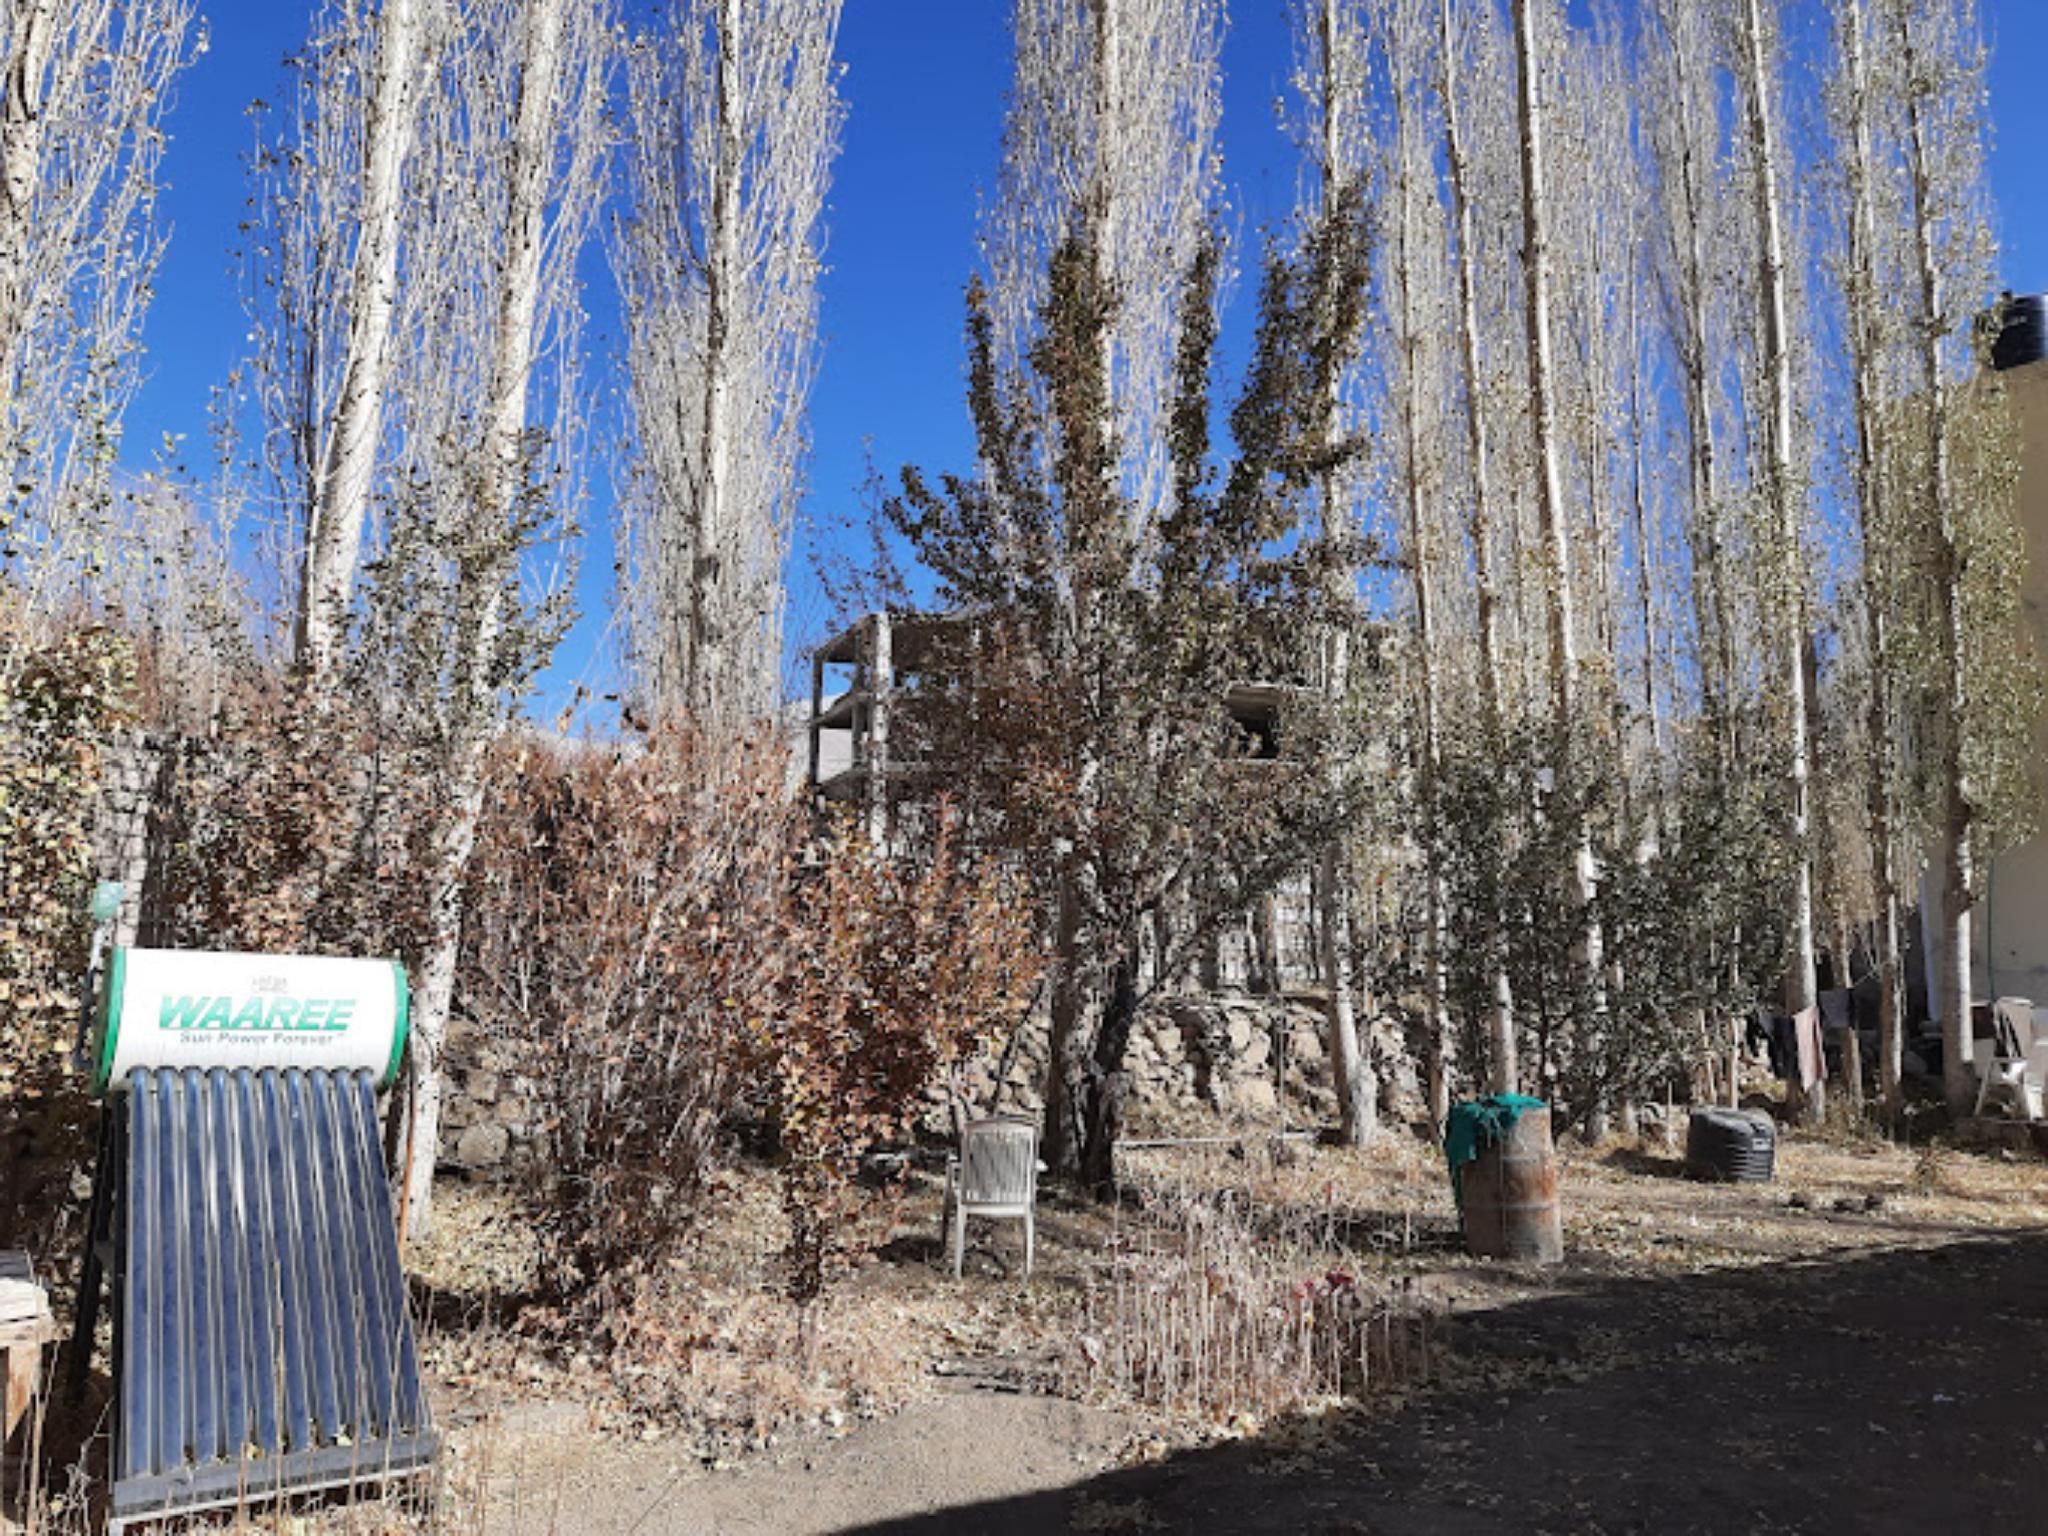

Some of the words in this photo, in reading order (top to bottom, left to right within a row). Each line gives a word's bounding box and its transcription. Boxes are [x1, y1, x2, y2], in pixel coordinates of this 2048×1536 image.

[159, 996, 354, 1030] WAAREE
[180, 1031, 212, 1044] Sun
[217, 1032, 268, 1045] Power
[273, 1032, 334, 1045] Forever
